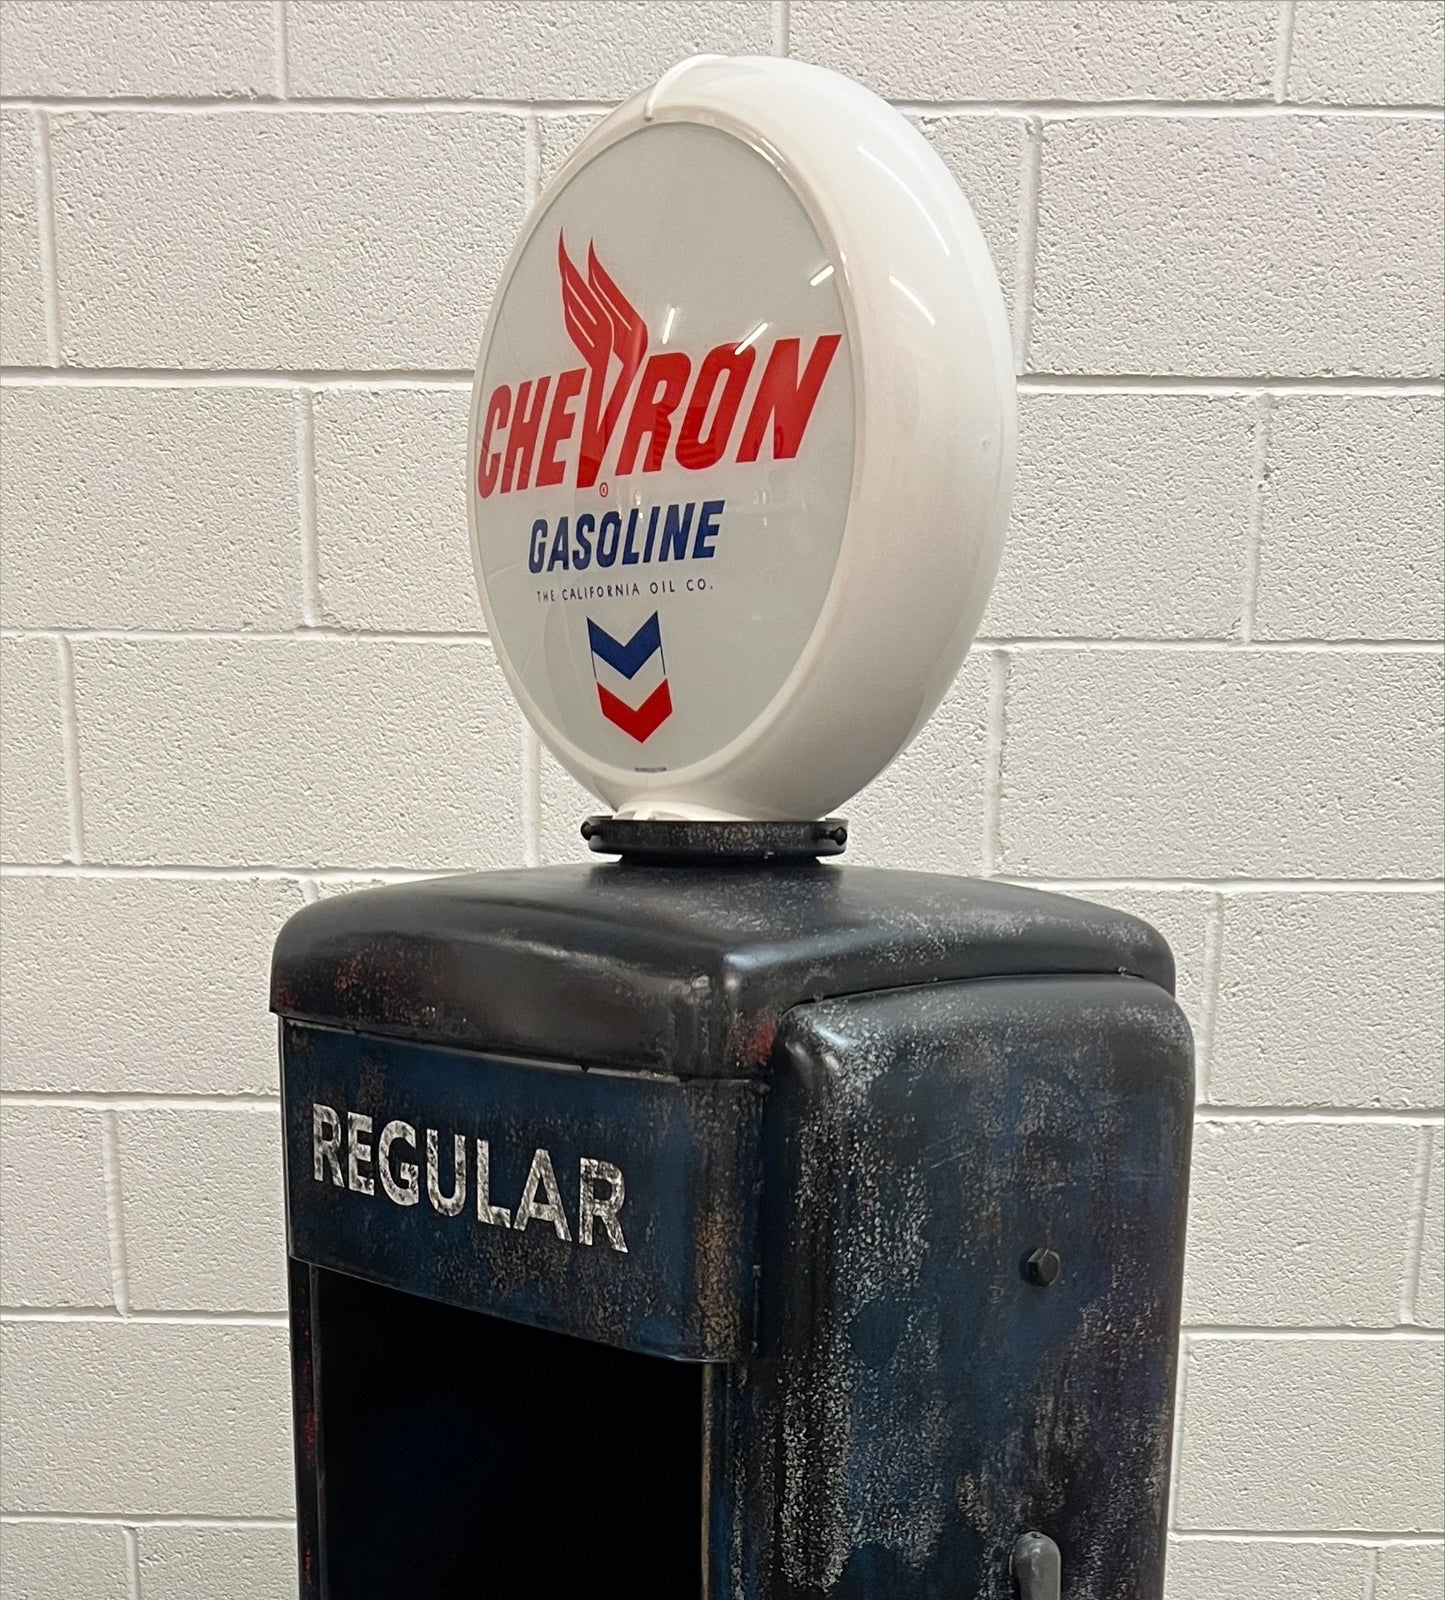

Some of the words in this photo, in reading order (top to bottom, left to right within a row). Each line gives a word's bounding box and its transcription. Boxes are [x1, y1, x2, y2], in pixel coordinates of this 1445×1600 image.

[478, 226, 842, 499] CHEVRON
[528, 500, 725, 574] GASOLINE
[537, 589, 555, 602] THE
[562, 583, 640, 601] CALIFORNIA
[650, 580, 675, 594] OIL
[686, 578, 713, 592] CO.
[312, 1103, 629, 1254] REGULAR
